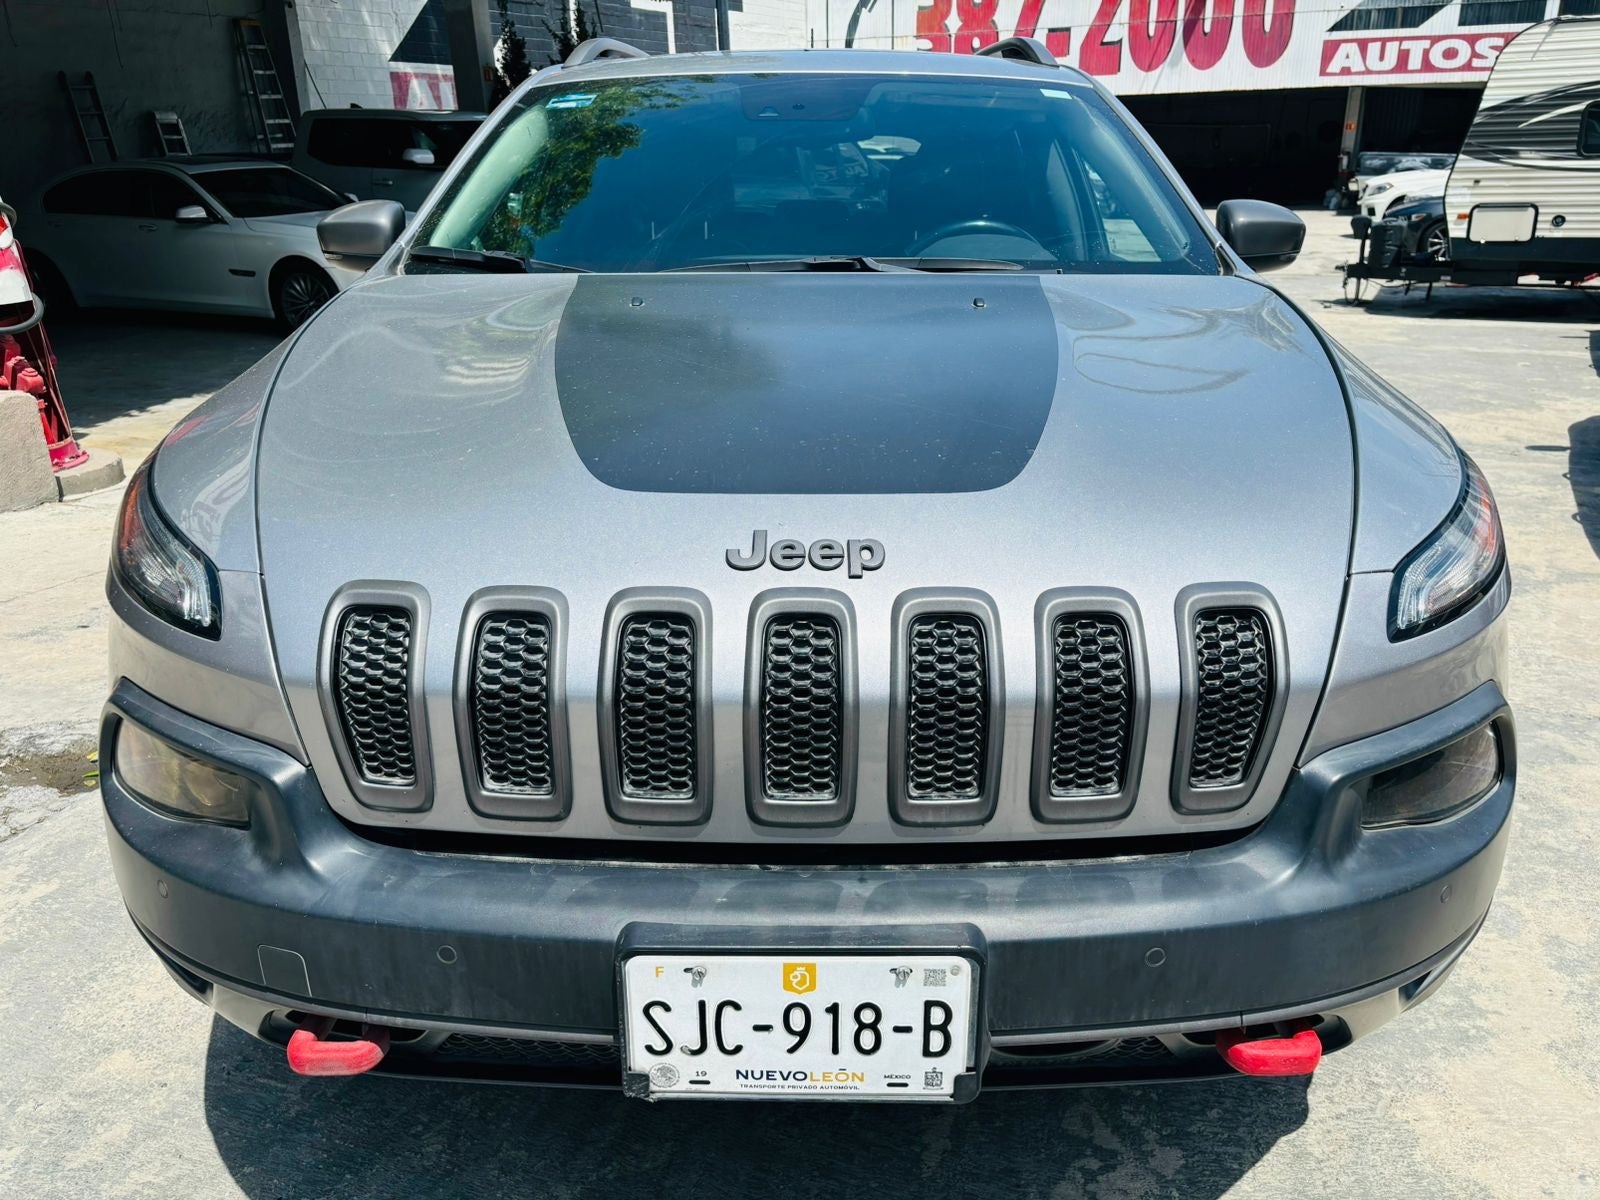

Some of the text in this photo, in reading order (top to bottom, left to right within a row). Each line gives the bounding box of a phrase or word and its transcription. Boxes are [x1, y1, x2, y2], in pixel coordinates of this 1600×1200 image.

[1325, 37, 1504, 74] AUTOS
[725, 529, 886, 579] Jeep
[642, 999, 953, 1059] SJC-918-B
